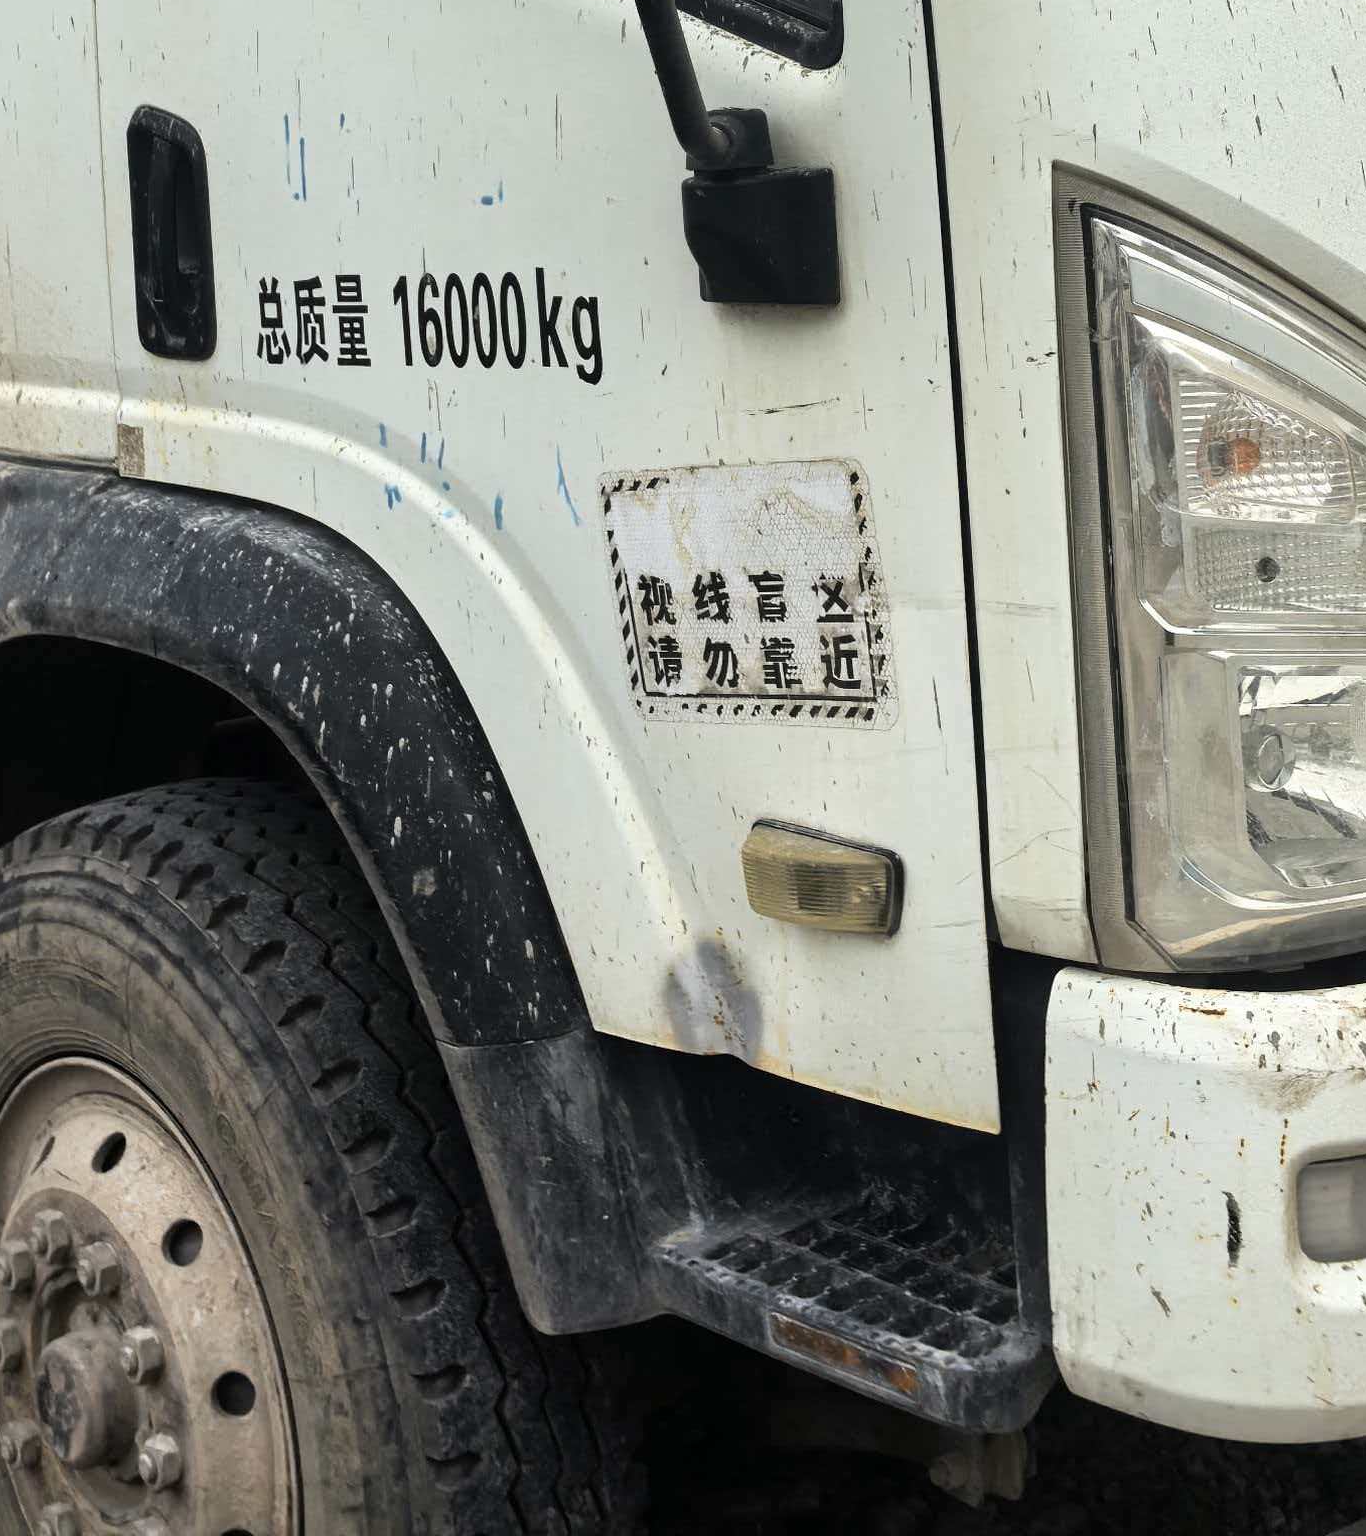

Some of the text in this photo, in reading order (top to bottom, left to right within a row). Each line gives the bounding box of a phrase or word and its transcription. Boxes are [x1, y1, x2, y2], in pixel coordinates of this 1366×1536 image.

[256, 267, 604, 386] 总质量 16000kg
[637, 569, 855, 625] 视线盲区
[647, 634, 862, 690] 请勿靠近
